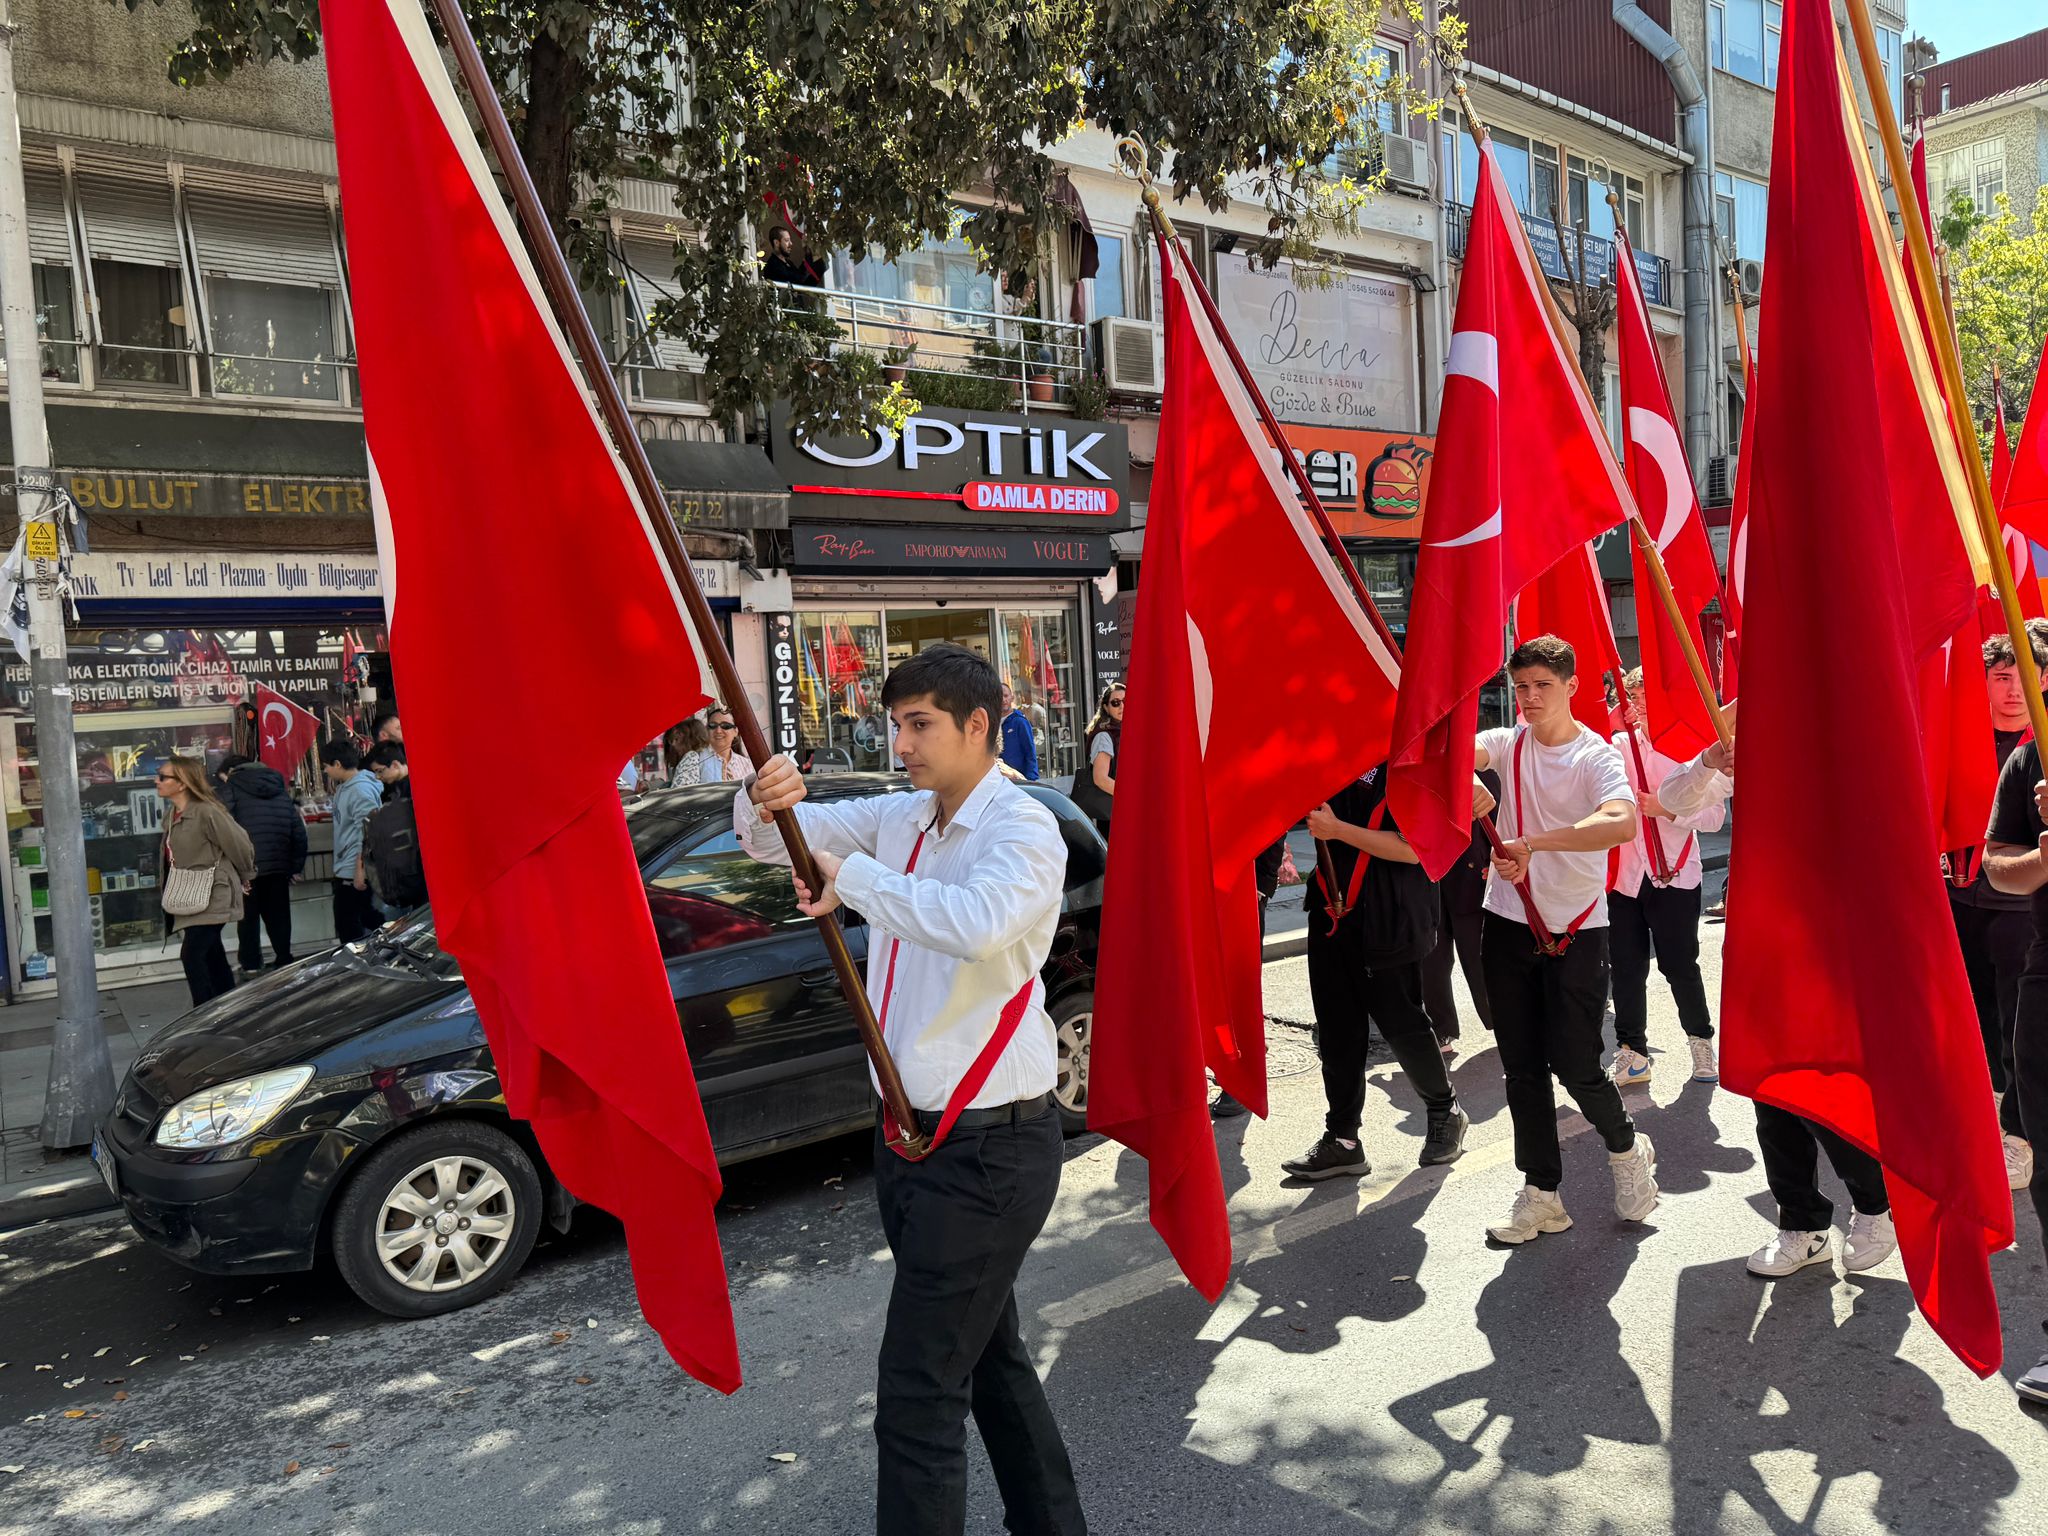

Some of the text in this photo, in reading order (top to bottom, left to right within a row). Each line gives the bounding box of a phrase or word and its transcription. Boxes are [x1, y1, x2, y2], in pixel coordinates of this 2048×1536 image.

[1260, 290, 1381, 370] Becca
[1328, 378, 1363, 390] SALONU
[1271, 385, 1377, 417] Gözde & Buse
[70, 477, 372, 513] BULUT ELEKTR
[977, 484, 1046, 509] DAMLA
[707, 501, 722, 519] 22
[813, 534, 876, 560] Ray-Ban
[905, 543, 1007, 560] EMPORIO ARMANI
[1032, 540, 1089, 561] VOGUE
[117, 562, 378, 591] Tv Led Lcd Plazma Uydu Bilgisayar
[1097, 651, 1120, 660] VOGUE
[97, 659, 184, 678] ELEKTRONİK
[231, 657, 272, 674] TAMİR
[275, 659, 292, 671] VE
[295, 657, 339, 671] BAKIMI
[197, 683, 214, 696] VE
[280, 678, 328, 693] YAPILIR
